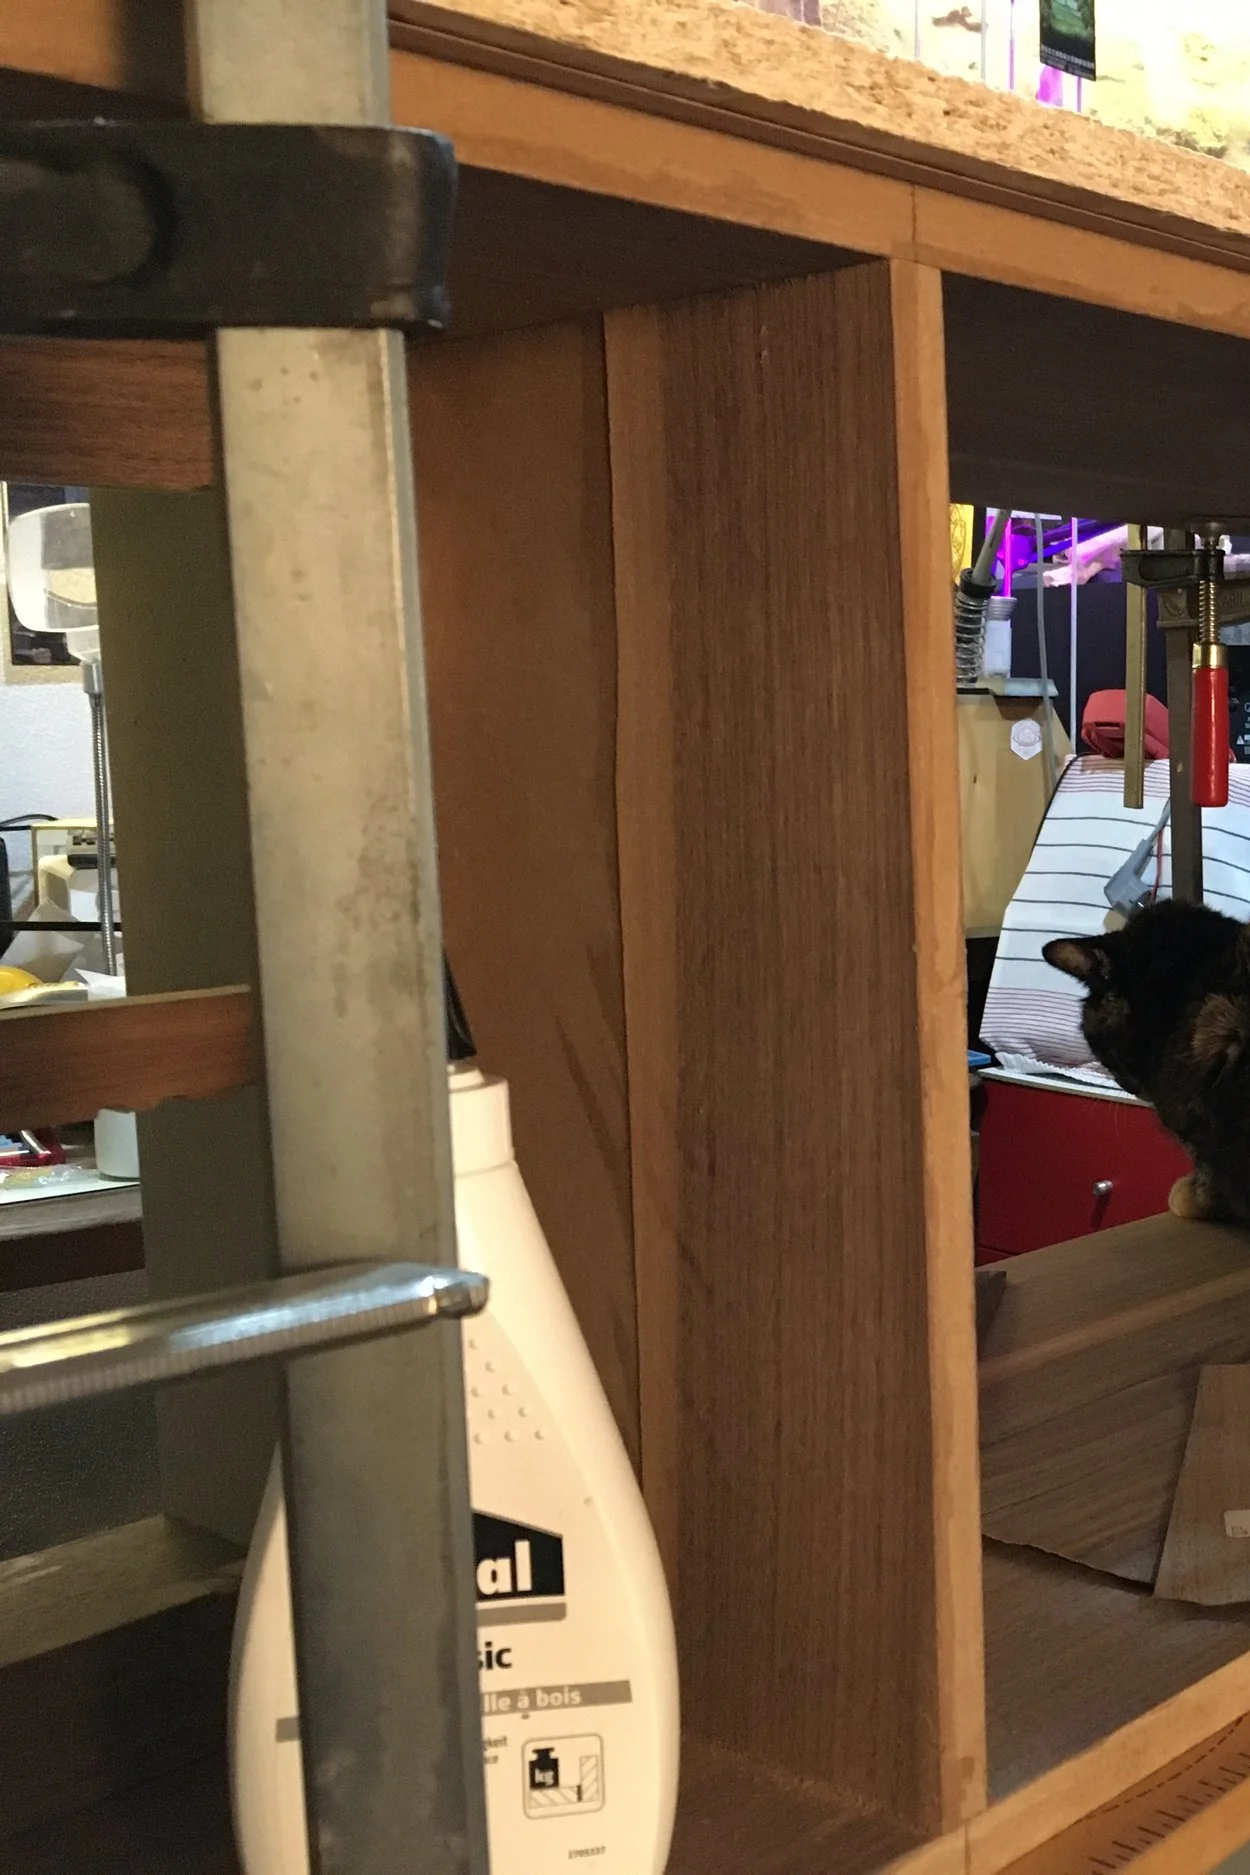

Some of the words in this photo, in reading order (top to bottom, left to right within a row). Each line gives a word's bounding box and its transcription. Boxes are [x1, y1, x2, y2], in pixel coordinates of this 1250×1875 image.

[517, 1690, 530, 1709] à
[536, 1686, 581, 1708] bois
[534, 1768, 555, 1787] kg
